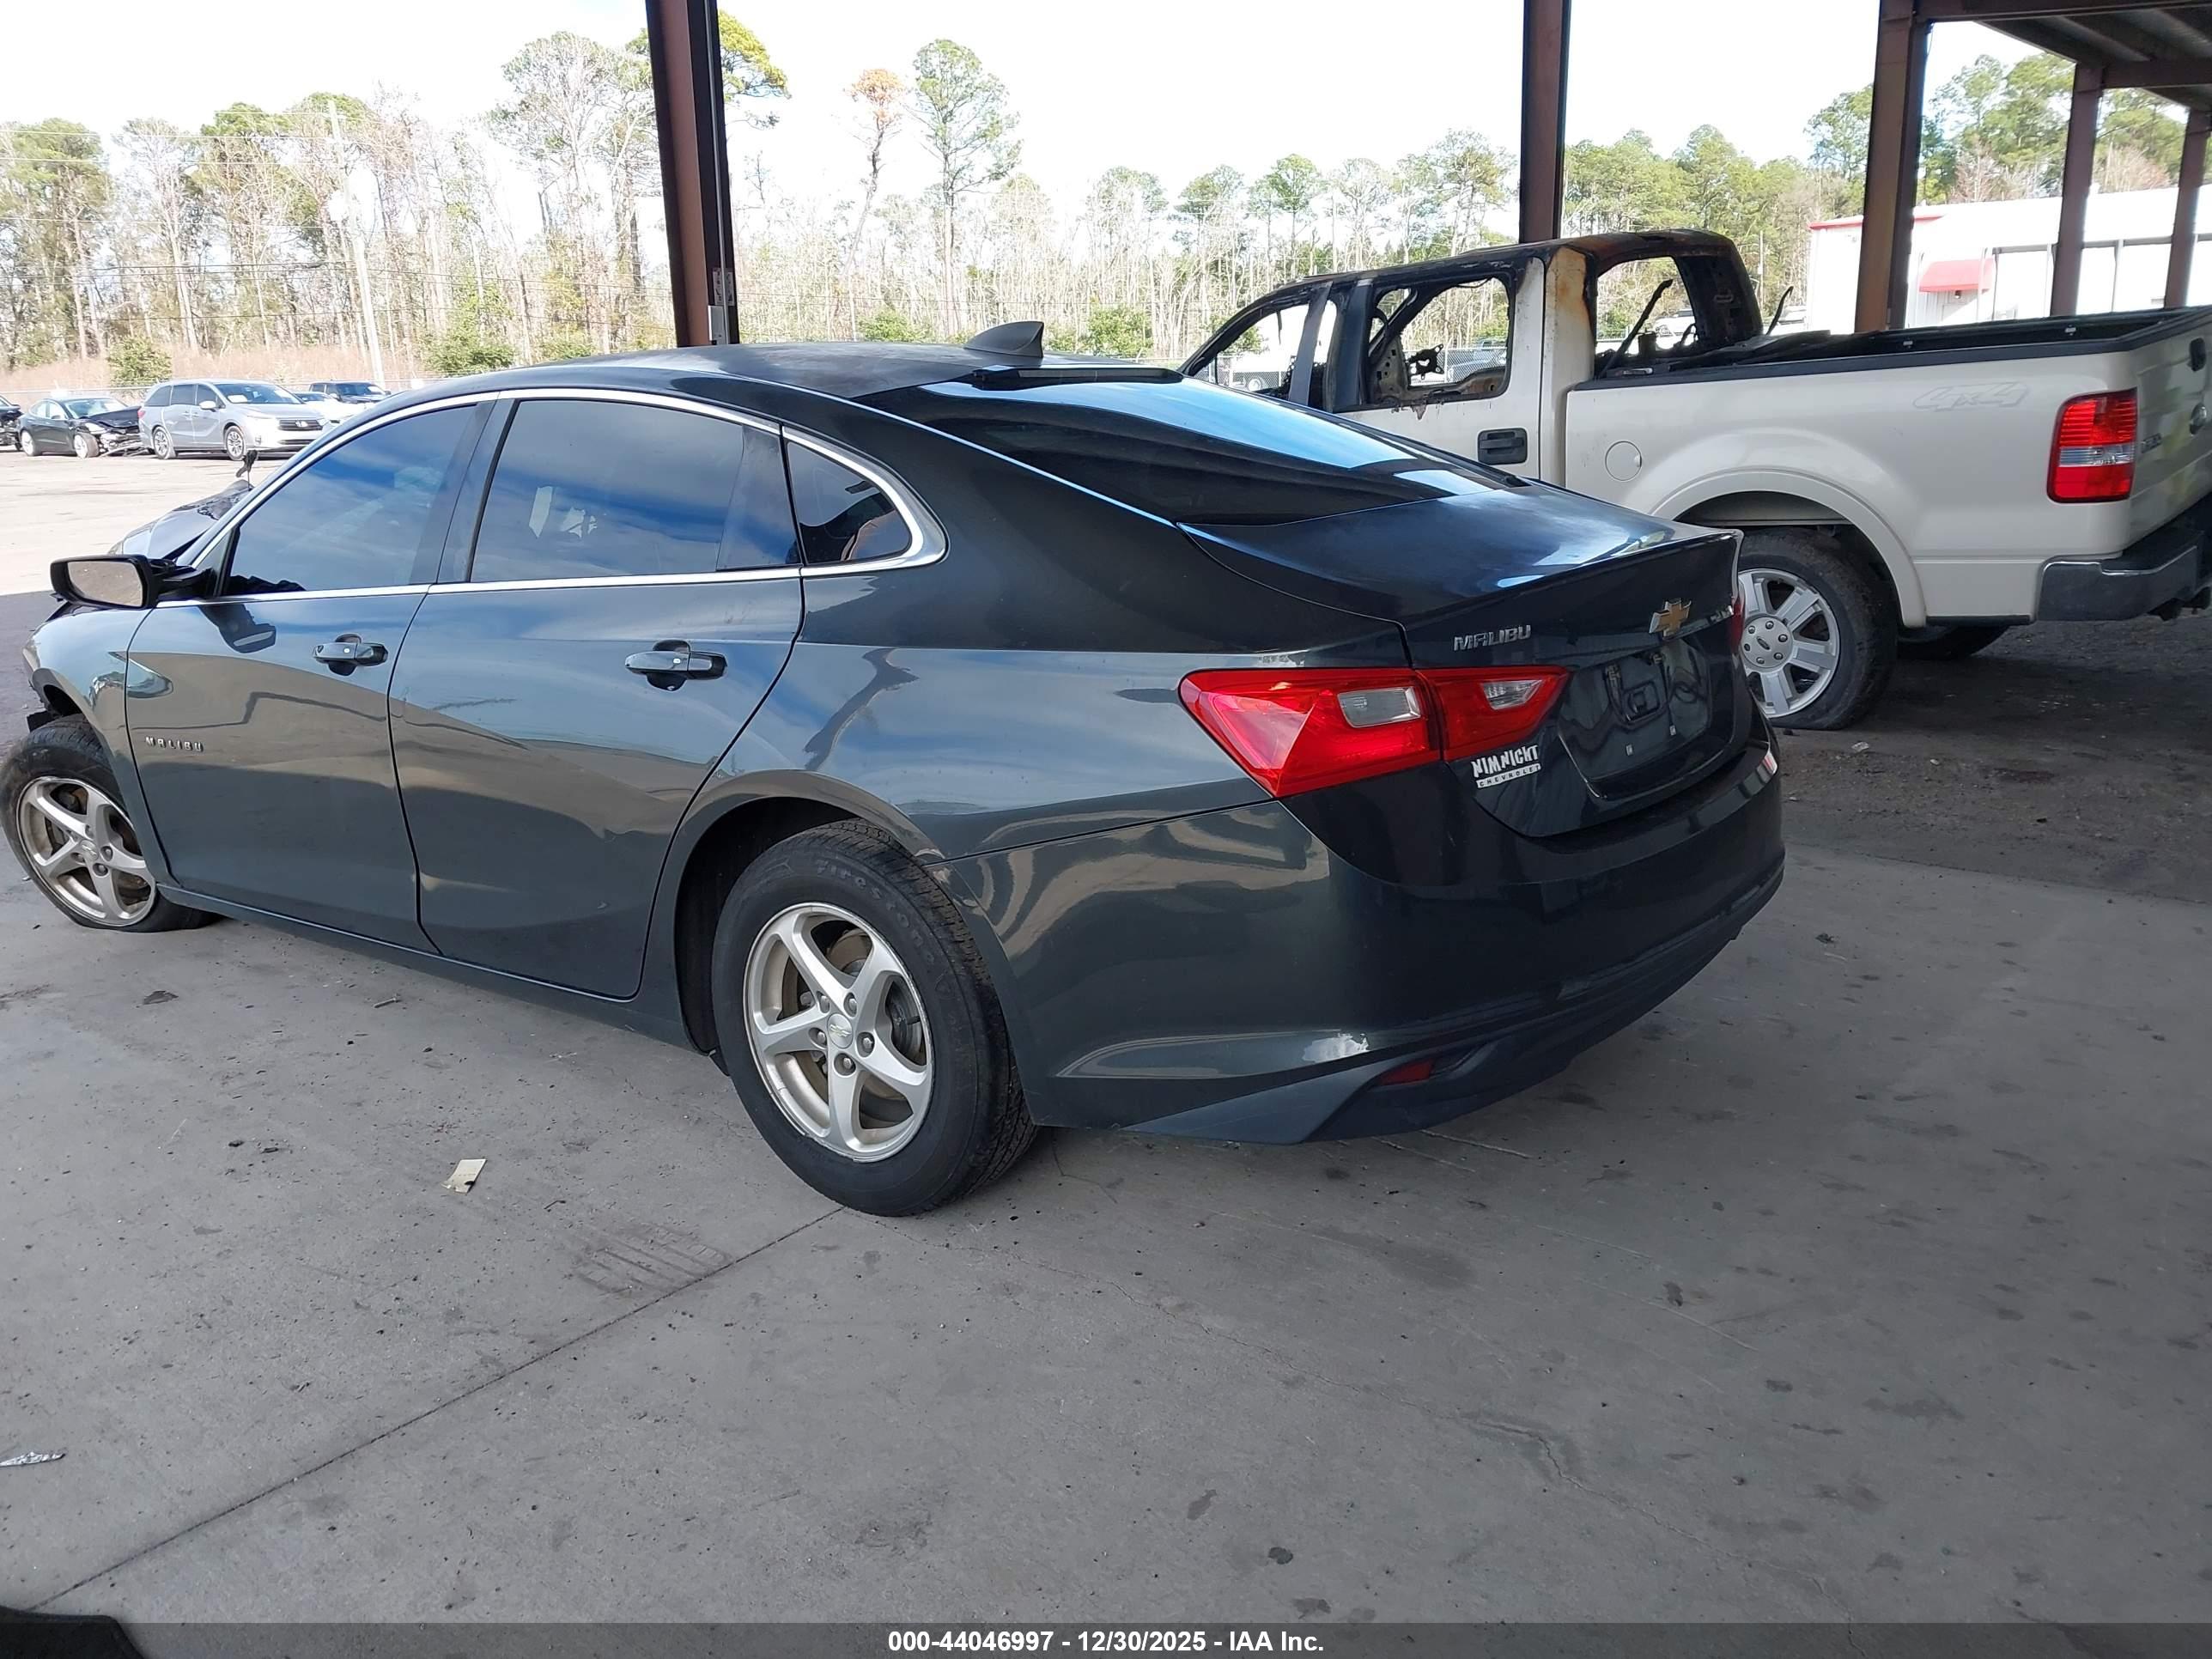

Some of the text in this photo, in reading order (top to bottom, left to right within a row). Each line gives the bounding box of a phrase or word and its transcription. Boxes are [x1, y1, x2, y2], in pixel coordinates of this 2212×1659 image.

[1454, 624, 1531, 651] MALIBU
[145, 736, 204, 752] MALIBU
[1479, 765, 1540, 787] CHEVROLET
